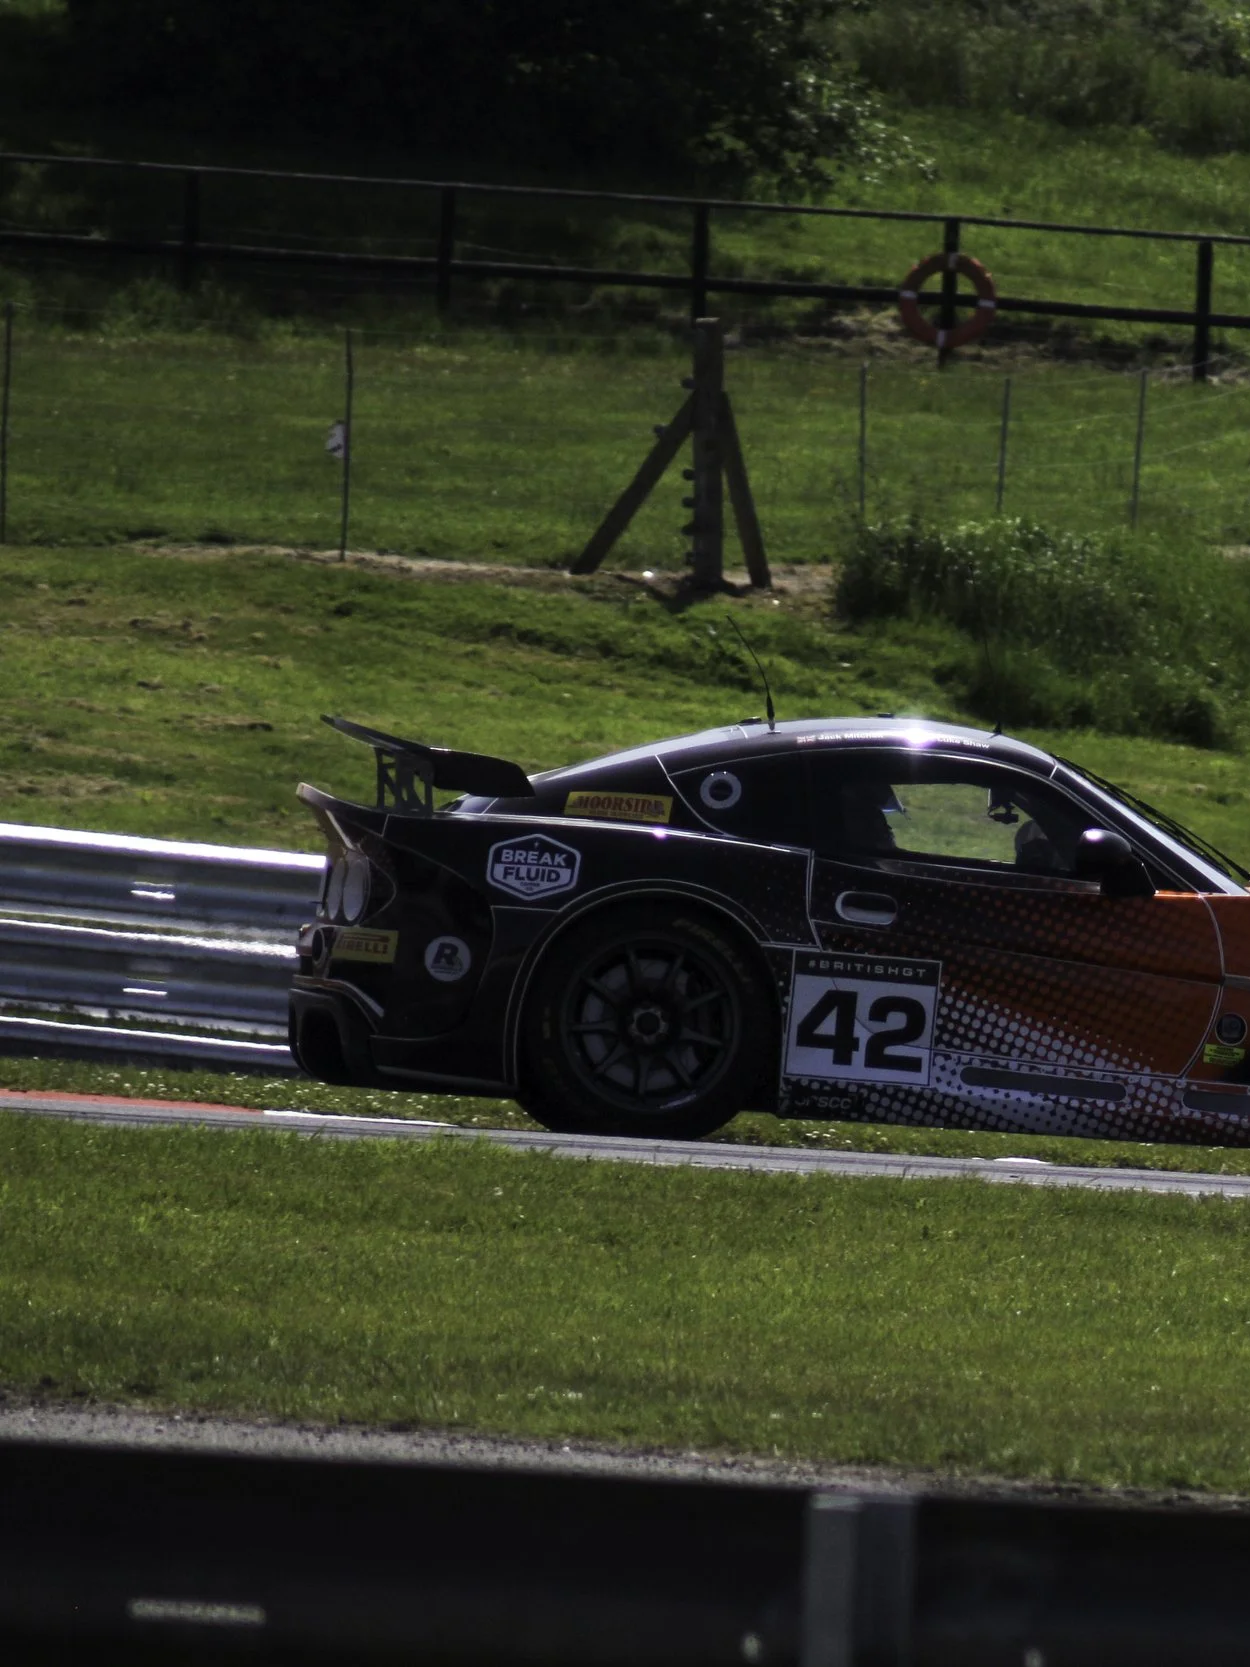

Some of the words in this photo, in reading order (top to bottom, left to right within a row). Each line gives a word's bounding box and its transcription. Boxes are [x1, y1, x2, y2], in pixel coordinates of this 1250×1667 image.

[501, 849, 567, 866] BREAK
[503, 866, 561, 883] FLUID
[808, 959, 928, 978] #BRITISHGT
[795, 989, 927, 1073] 42
